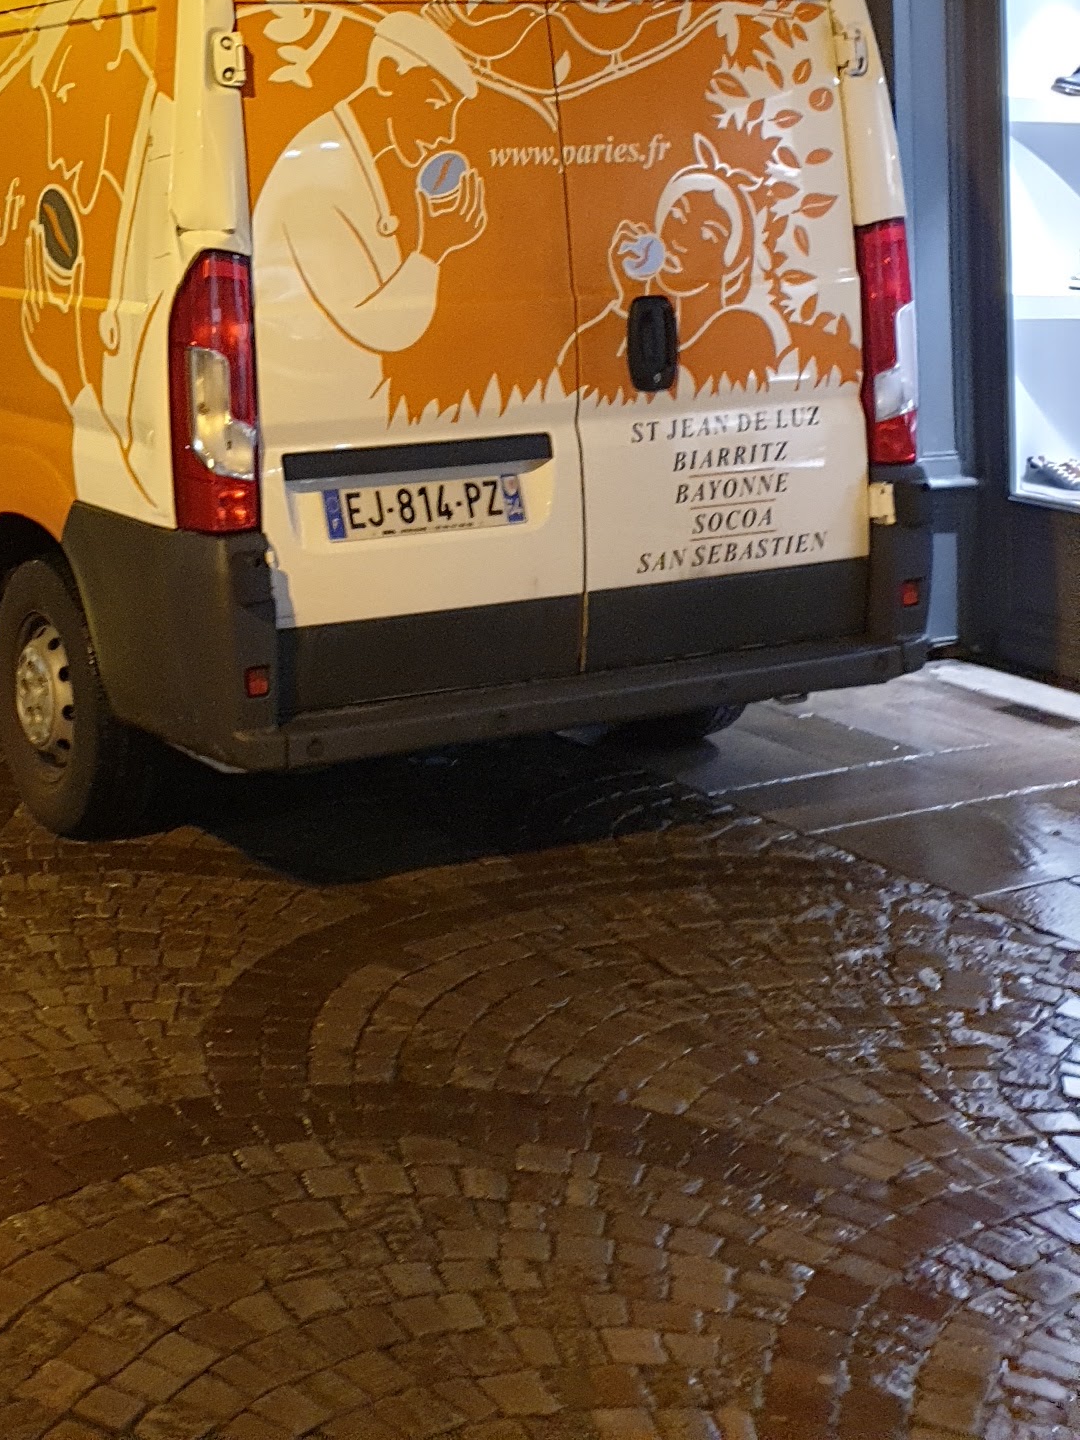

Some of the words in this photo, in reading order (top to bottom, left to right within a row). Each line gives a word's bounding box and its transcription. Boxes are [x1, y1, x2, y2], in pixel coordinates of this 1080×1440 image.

[490, 133, 671, 174] www.paries.fr
[631, 421, 660, 444] ST
[666, 413, 729, 441] JEAN
[736, 410, 769, 433] DE
[776, 405, 820, 429] LUZ
[672, 440, 789, 472] BIARRITZ
[674, 472, 790, 504] BAYONNE
[691, 507, 773, 535] SOCOA
[636, 548, 688, 575] SAN
[690, 531, 828, 568] SEBASTIEN
